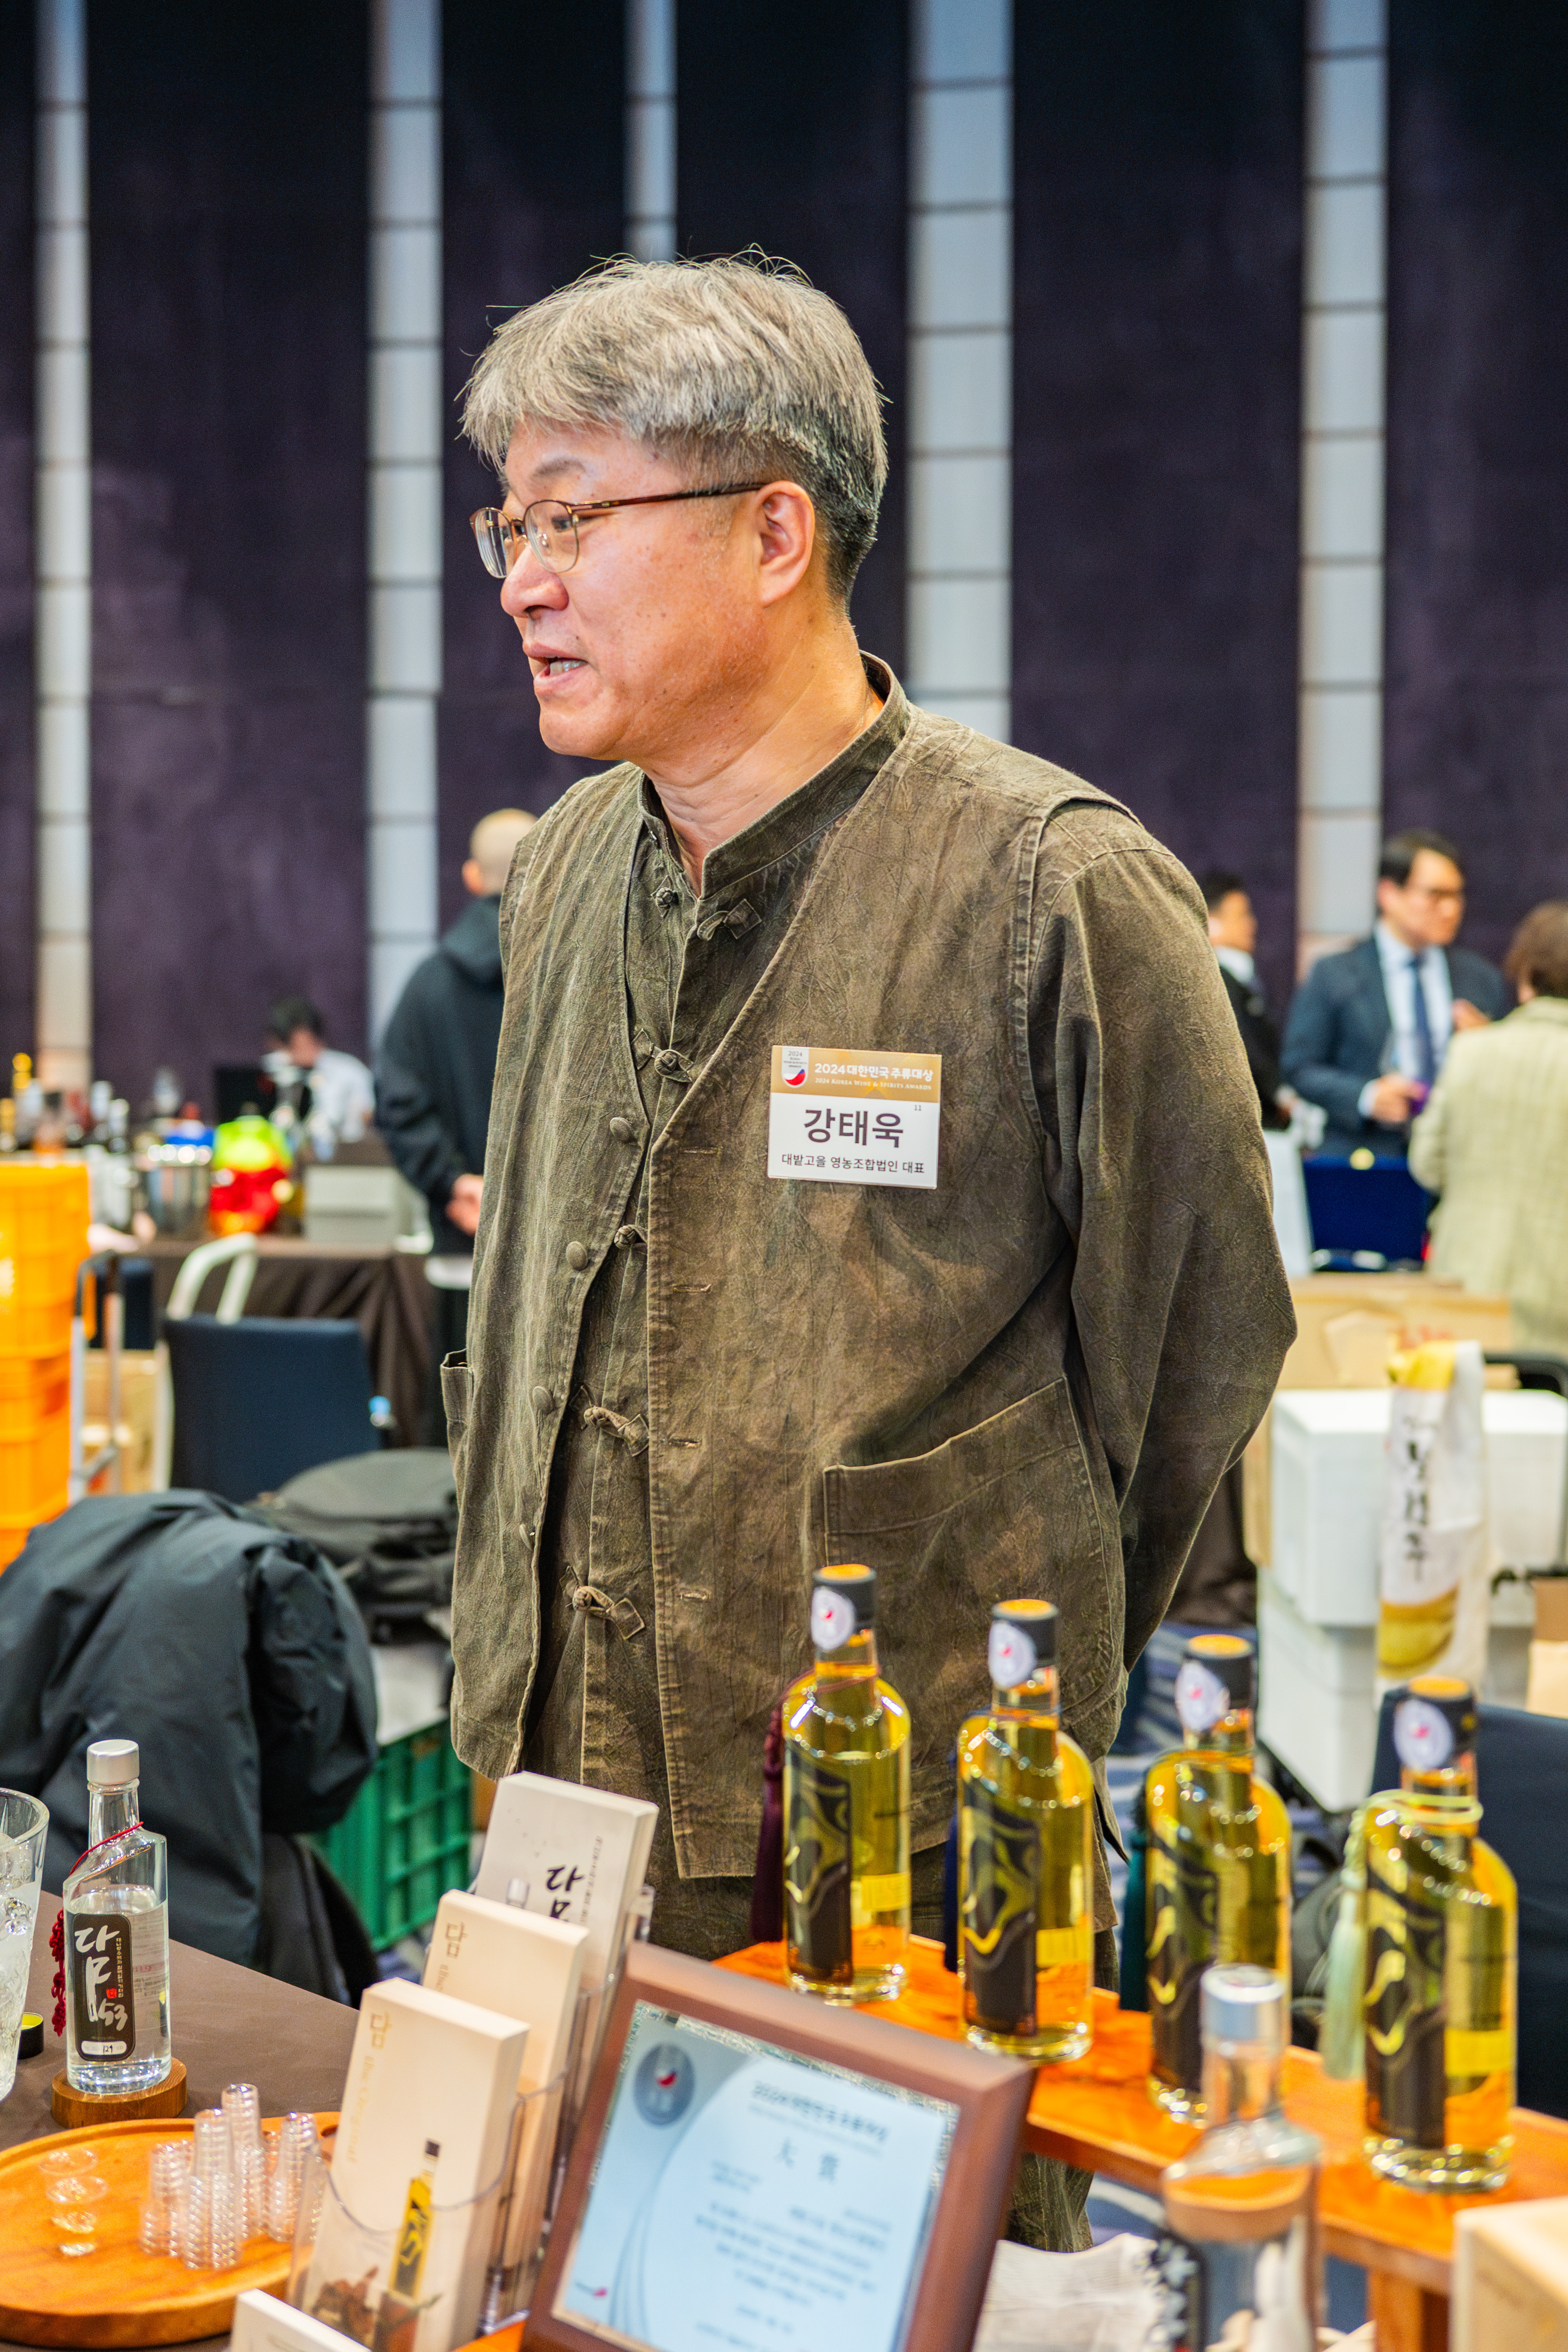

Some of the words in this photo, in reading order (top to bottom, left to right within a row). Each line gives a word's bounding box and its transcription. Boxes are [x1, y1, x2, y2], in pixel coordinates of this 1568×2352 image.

[815, 1063, 845, 1074] 2024
[847, 1065, 889, 1079] 대한민국
[891, 1068, 934, 1082] 주류대상
[804, 1108, 903, 1147] 강태욱
[782, 1153, 826, 1167] 대밭고을
[831, 1157, 898, 1172] 영농조합법인
[902, 1162, 925, 1173] 대표
